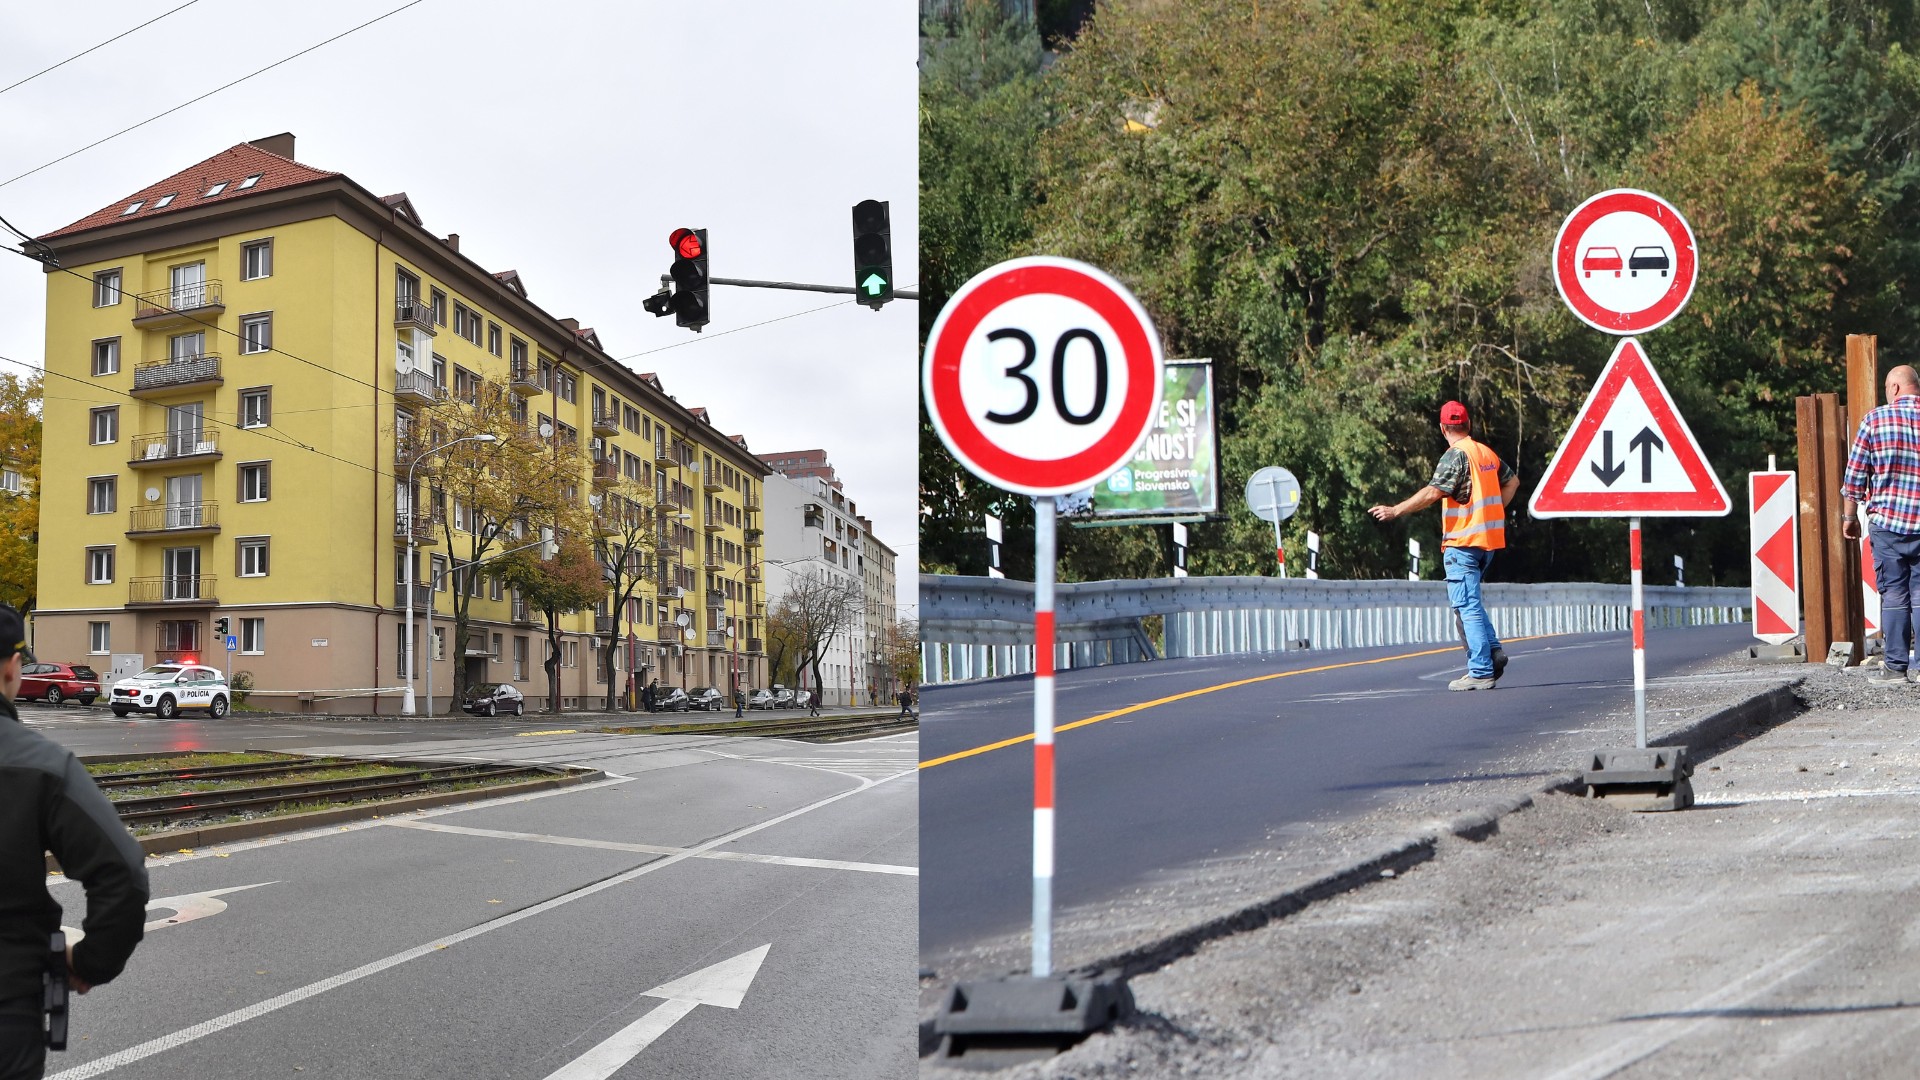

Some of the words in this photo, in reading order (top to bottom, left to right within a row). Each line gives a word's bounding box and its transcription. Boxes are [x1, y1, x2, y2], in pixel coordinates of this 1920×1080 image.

[984, 327, 1109, 426] 30
[1176, 398, 1196, 428] SI
[1134, 468, 1198, 481] Progresívne
[1134, 480, 1190, 492] Slovensko
